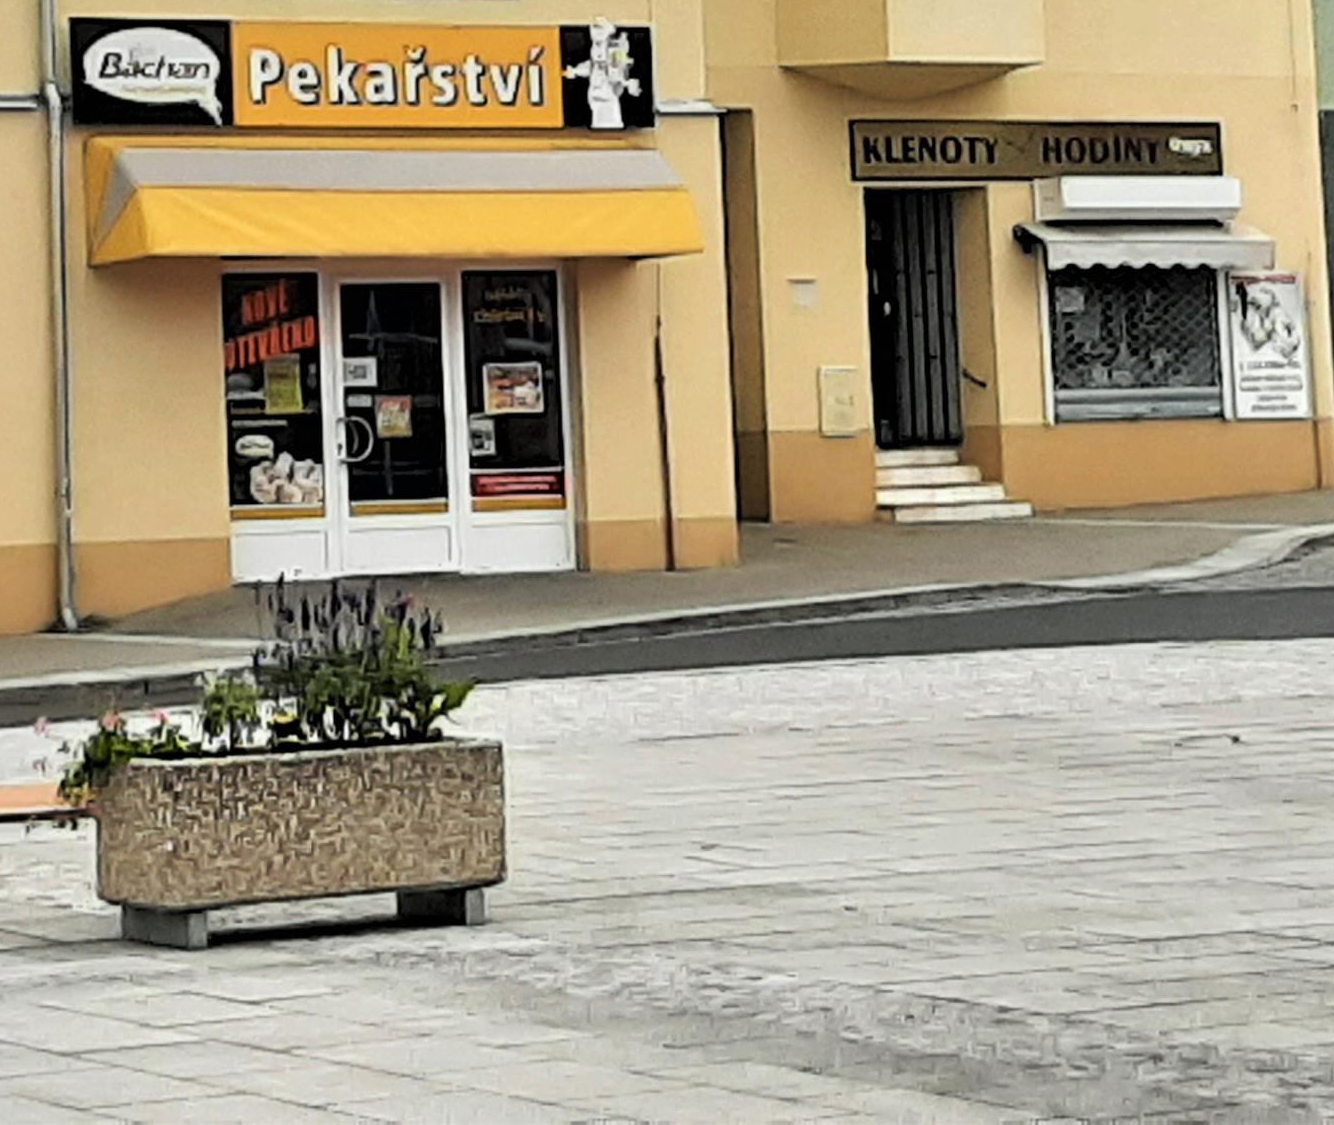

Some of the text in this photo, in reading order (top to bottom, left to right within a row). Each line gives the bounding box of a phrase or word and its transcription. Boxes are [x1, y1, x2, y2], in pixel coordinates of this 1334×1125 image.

[247, 44, 547, 109] Pekařství
[862, 136, 1000, 165] KLENOTY
[1040, 135, 1160, 166] HODINY
